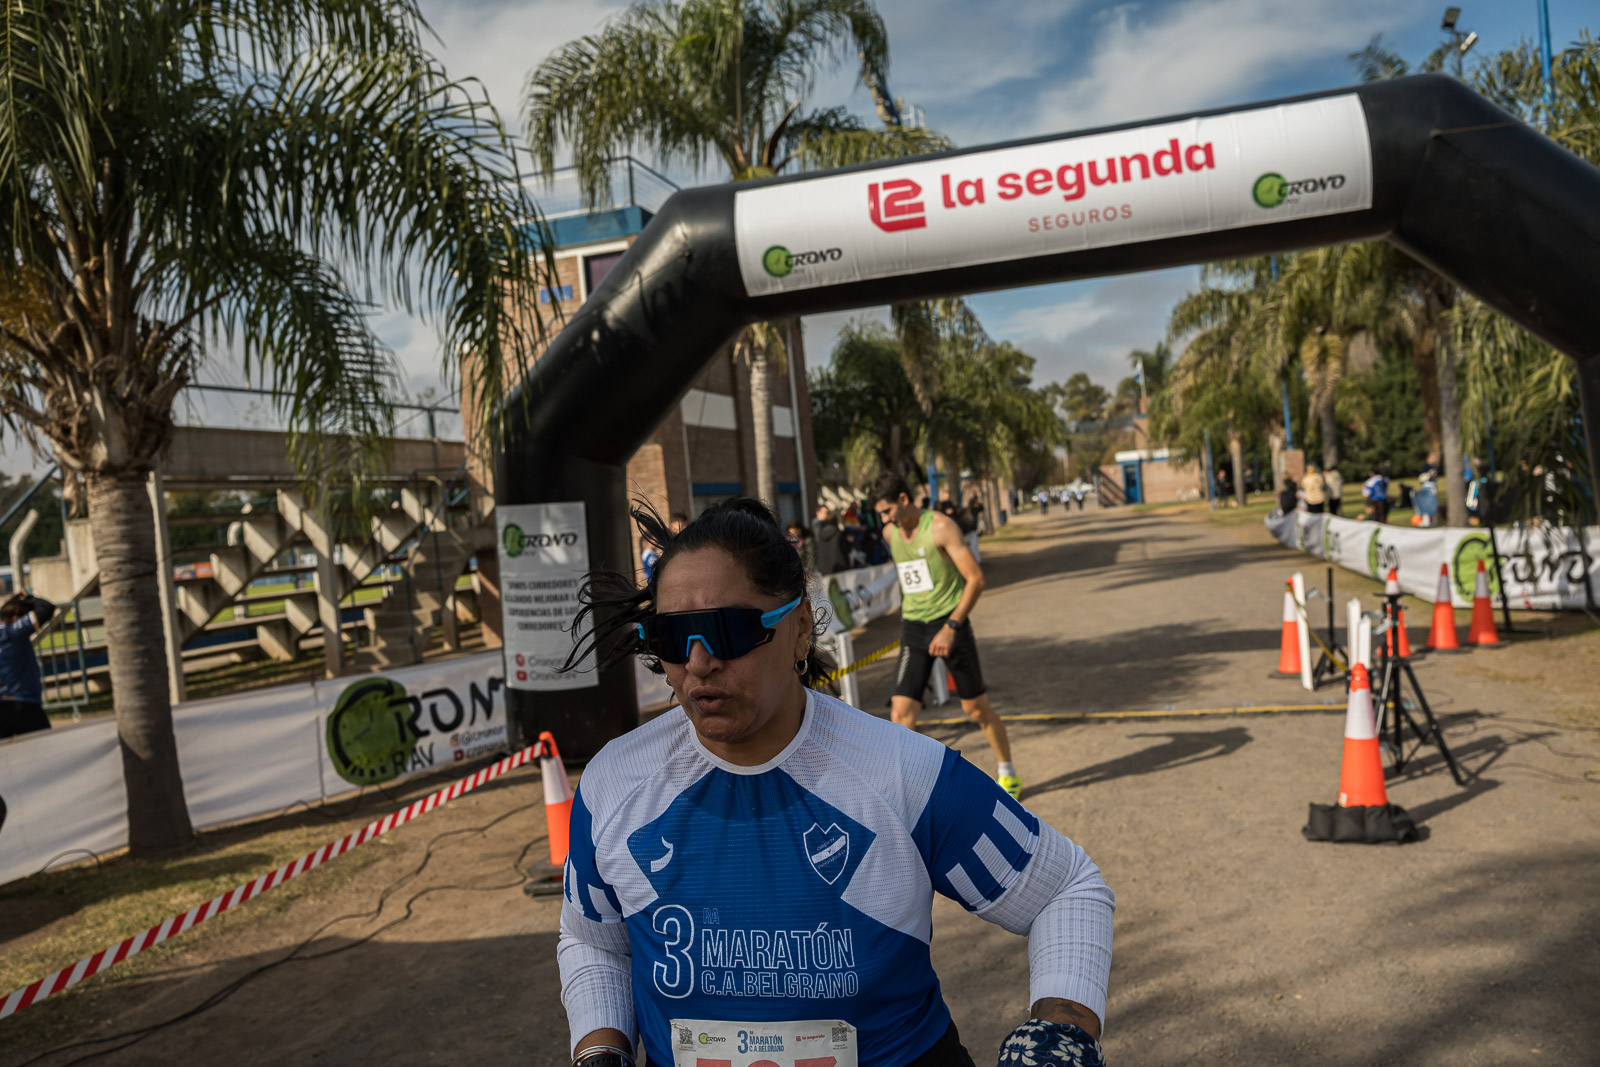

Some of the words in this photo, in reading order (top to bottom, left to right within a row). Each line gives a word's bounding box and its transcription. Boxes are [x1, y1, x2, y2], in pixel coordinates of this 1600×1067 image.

[941, 174, 985, 209] la
[997, 138, 1215, 201] segunda
[1027, 204, 1133, 233] SEGUROS
[903, 570, 922, 586] 83
[391, 743, 435, 776] RAV
[702, 907, 720, 925] RA
[653, 904, 694, 999] 3
[701, 922, 855, 970] MARATÓN
[701, 969, 859, 999] C.A.BELGRANO
[737, 1029, 749, 1054] 3
[749, 1034, 783, 1045] MARATÓN
